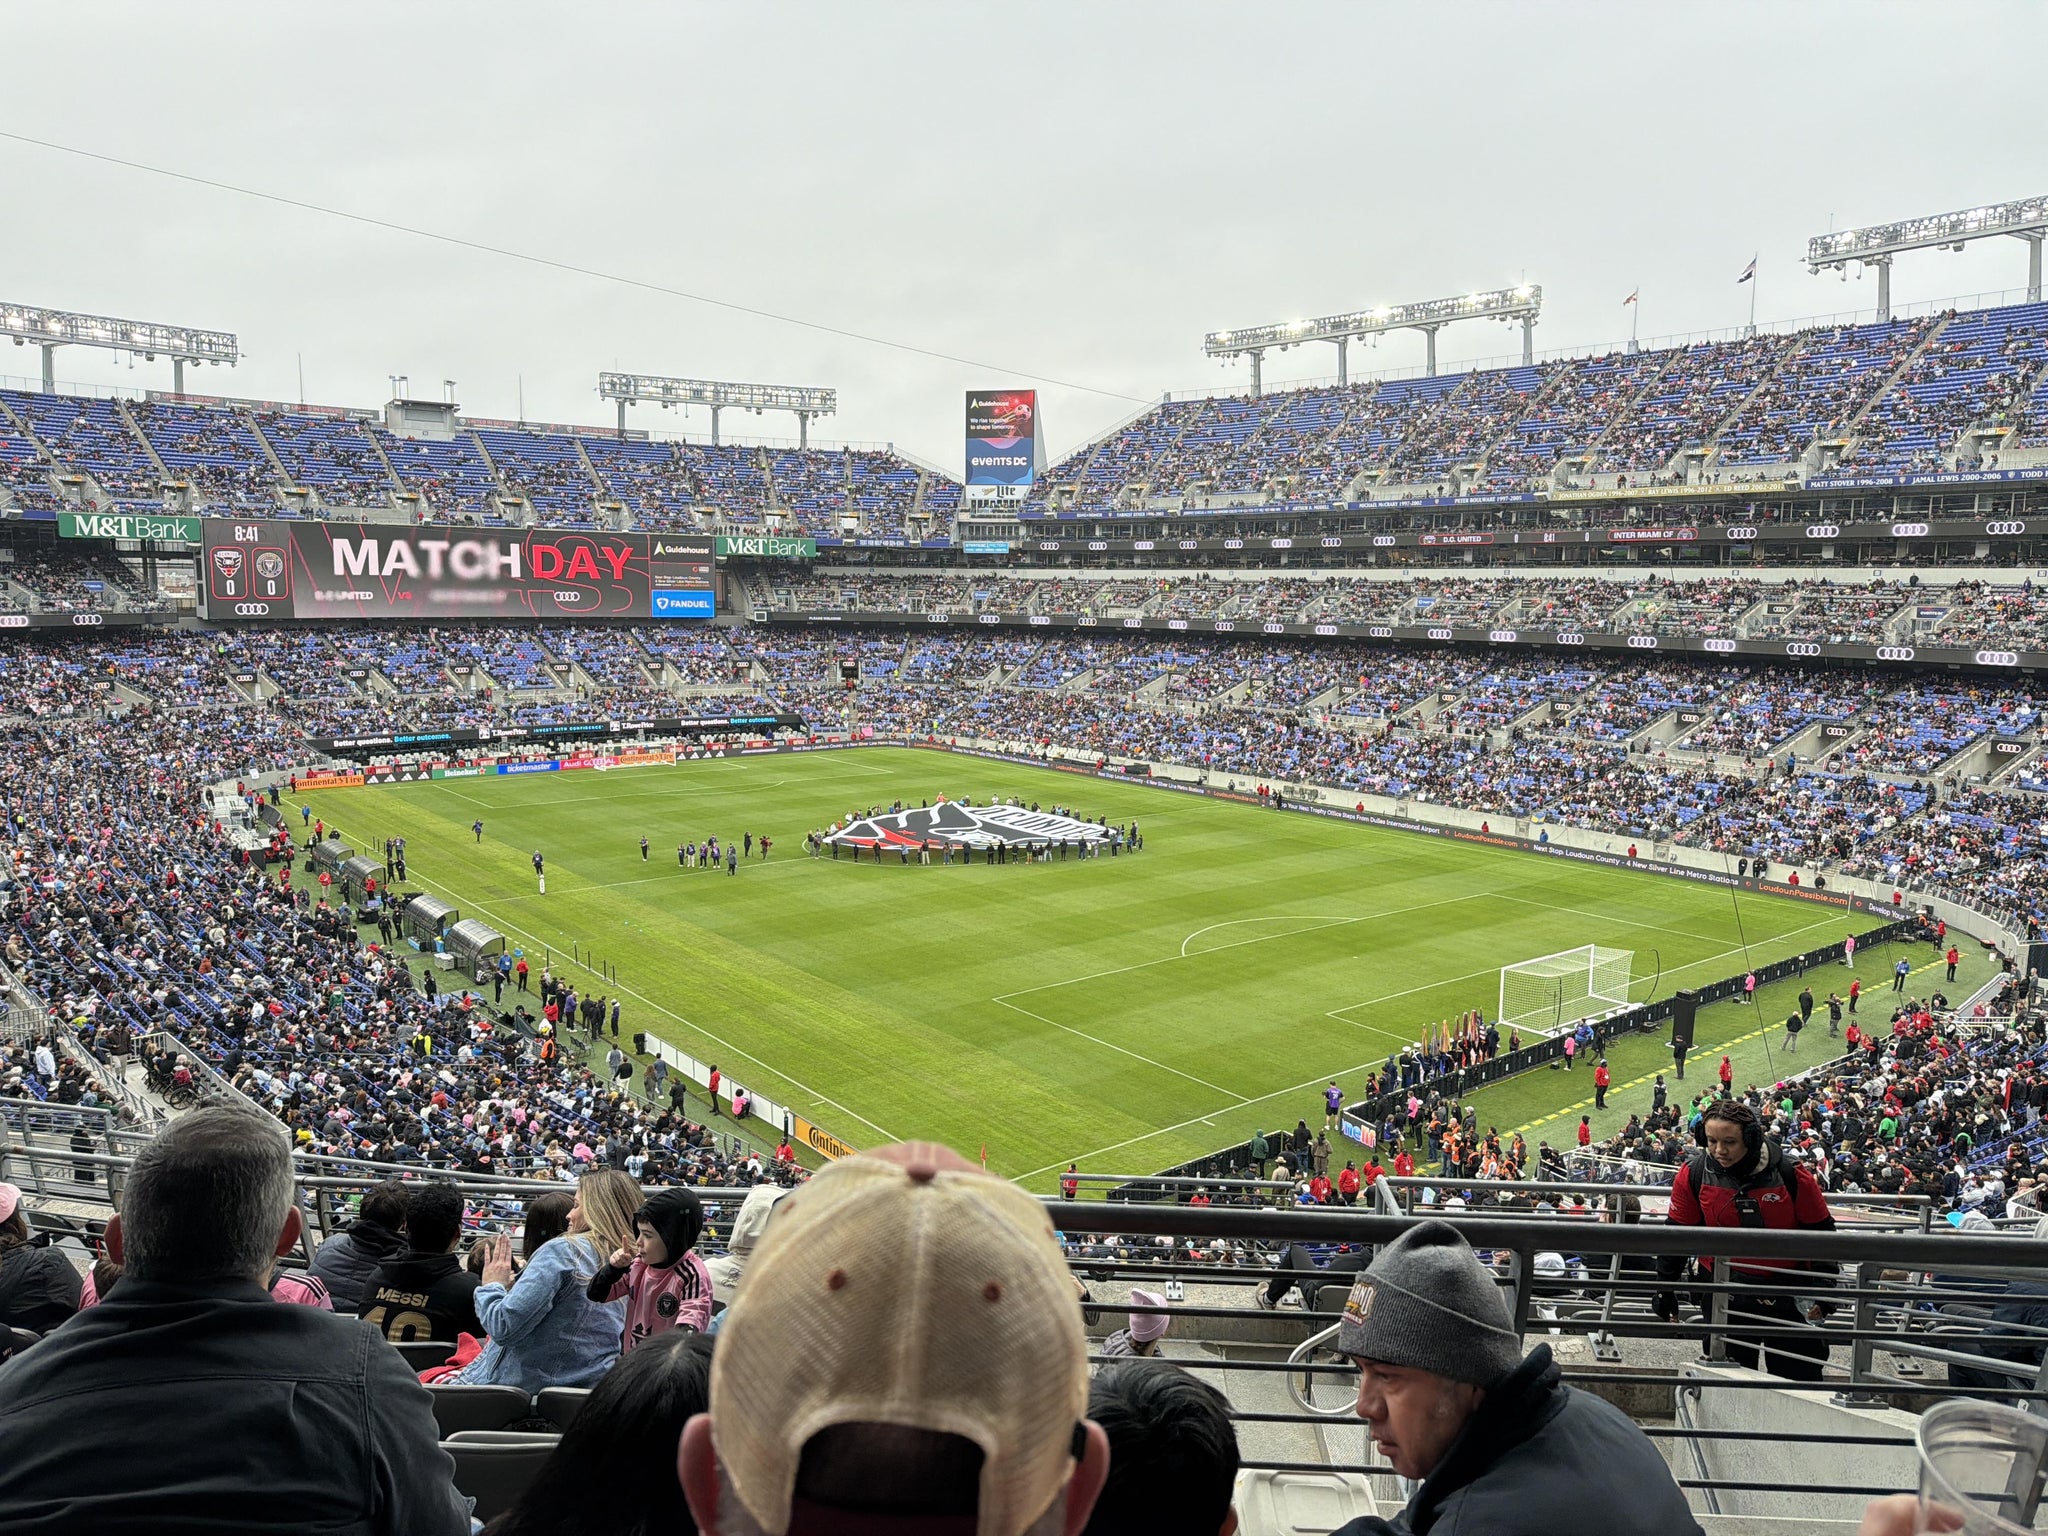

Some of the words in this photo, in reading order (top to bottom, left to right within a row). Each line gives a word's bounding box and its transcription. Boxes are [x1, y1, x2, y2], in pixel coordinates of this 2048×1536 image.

[1912, 475, 1936, 485] JAMAL
[1937, 474, 1959, 483] LEWIS
[1961, 472, 2002, 482] 2000-2006
[2021, 470, 2043, 479] TODD
[1856, 478, 1893, 487] 1996-2008
[996, 485, 1016, 498] Lite
[1648, 488, 1660, 496] RAY
[1732, 484, 1751, 492] REED
[74, 514, 134, 538] M&T
[136, 516, 189, 540] Bank
[234, 526, 258, 541] 8:41
[1613, 531, 1635, 540] INTER
[1637, 531, 1661, 539] MIAMI
[1663, 530, 1674, 538] CF
[1457, 535, 1482, 543] UNITED
[665, 546, 709, 554] Guidehouse
[726, 538, 768, 555] M&T
[769, 539, 806, 556] Bank
[227, 580, 235, 596] 0
[267, 580, 276, 596] 0
[670, 600, 710, 608] FANDUEL
[681, 719, 700, 727] Better
[700, 718, 729, 727] questions.
[334, 740, 356, 748] Better
[357, 738, 393, 748] questions.
[394, 736, 416, 744] Better
[417, 734, 452, 743] outcomes.
[563, 759, 580, 768] Audi
[620, 754, 655, 765] Continental
[444, 768, 478, 777] Heineken
[507, 763, 552, 773] ticketmaster
[296, 778, 337, 787] ontinental
[1310, 806, 1327, 817] Trophy
[1327, 809, 1342, 818] Office
[1356, 815, 1369, 823] From
[1370, 816, 1385, 825] Dulles
[1386, 819, 1420, 832] International
[1421, 824, 1440, 835] Airport
[1454, 831, 1518, 848] LoudounPossible.com
[1533, 844, 1548, 853] Next
[1565, 850, 1594, 861] Loudoun
[1595, 854, 1620, 866] County
[1632, 861, 1647, 870] New
[1649, 863, 1668, 875] Silver
[1669, 867, 1684, 878] Line
[1686, 869, 1707, 882] Metro
[1708, 873, 1739, 886] Stations
[1758, 882, 1848, 906] LoudounPossible.com
[1868, 903, 1890, 917] Develop
[809, 1126, 856, 1158] Continen
[375, 1287, 430, 1308] MESSI
